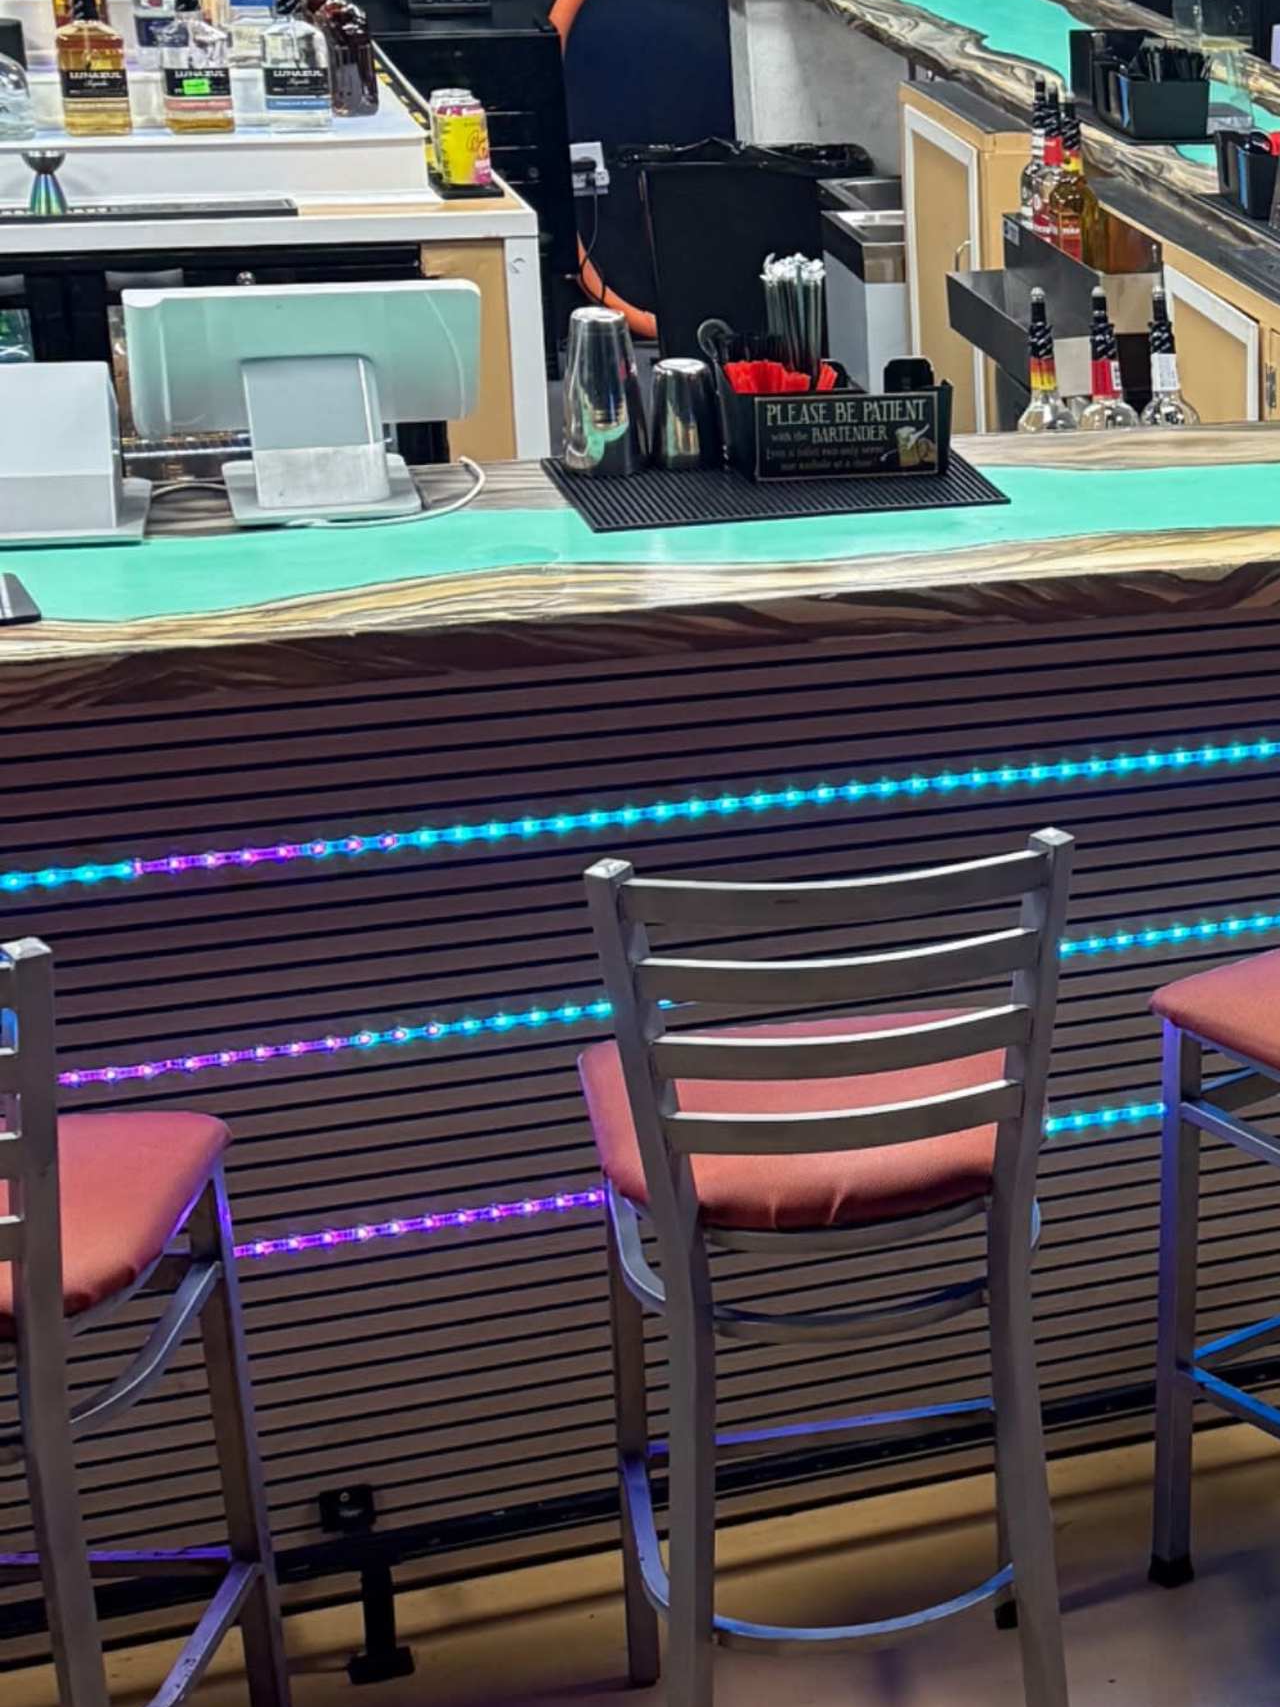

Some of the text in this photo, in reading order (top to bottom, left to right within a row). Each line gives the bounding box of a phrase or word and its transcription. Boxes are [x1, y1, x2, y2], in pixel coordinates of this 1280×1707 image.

[767, 399, 927, 425] PLEASE BE PATIENT
[812, 425, 888, 444] BARTENDER
